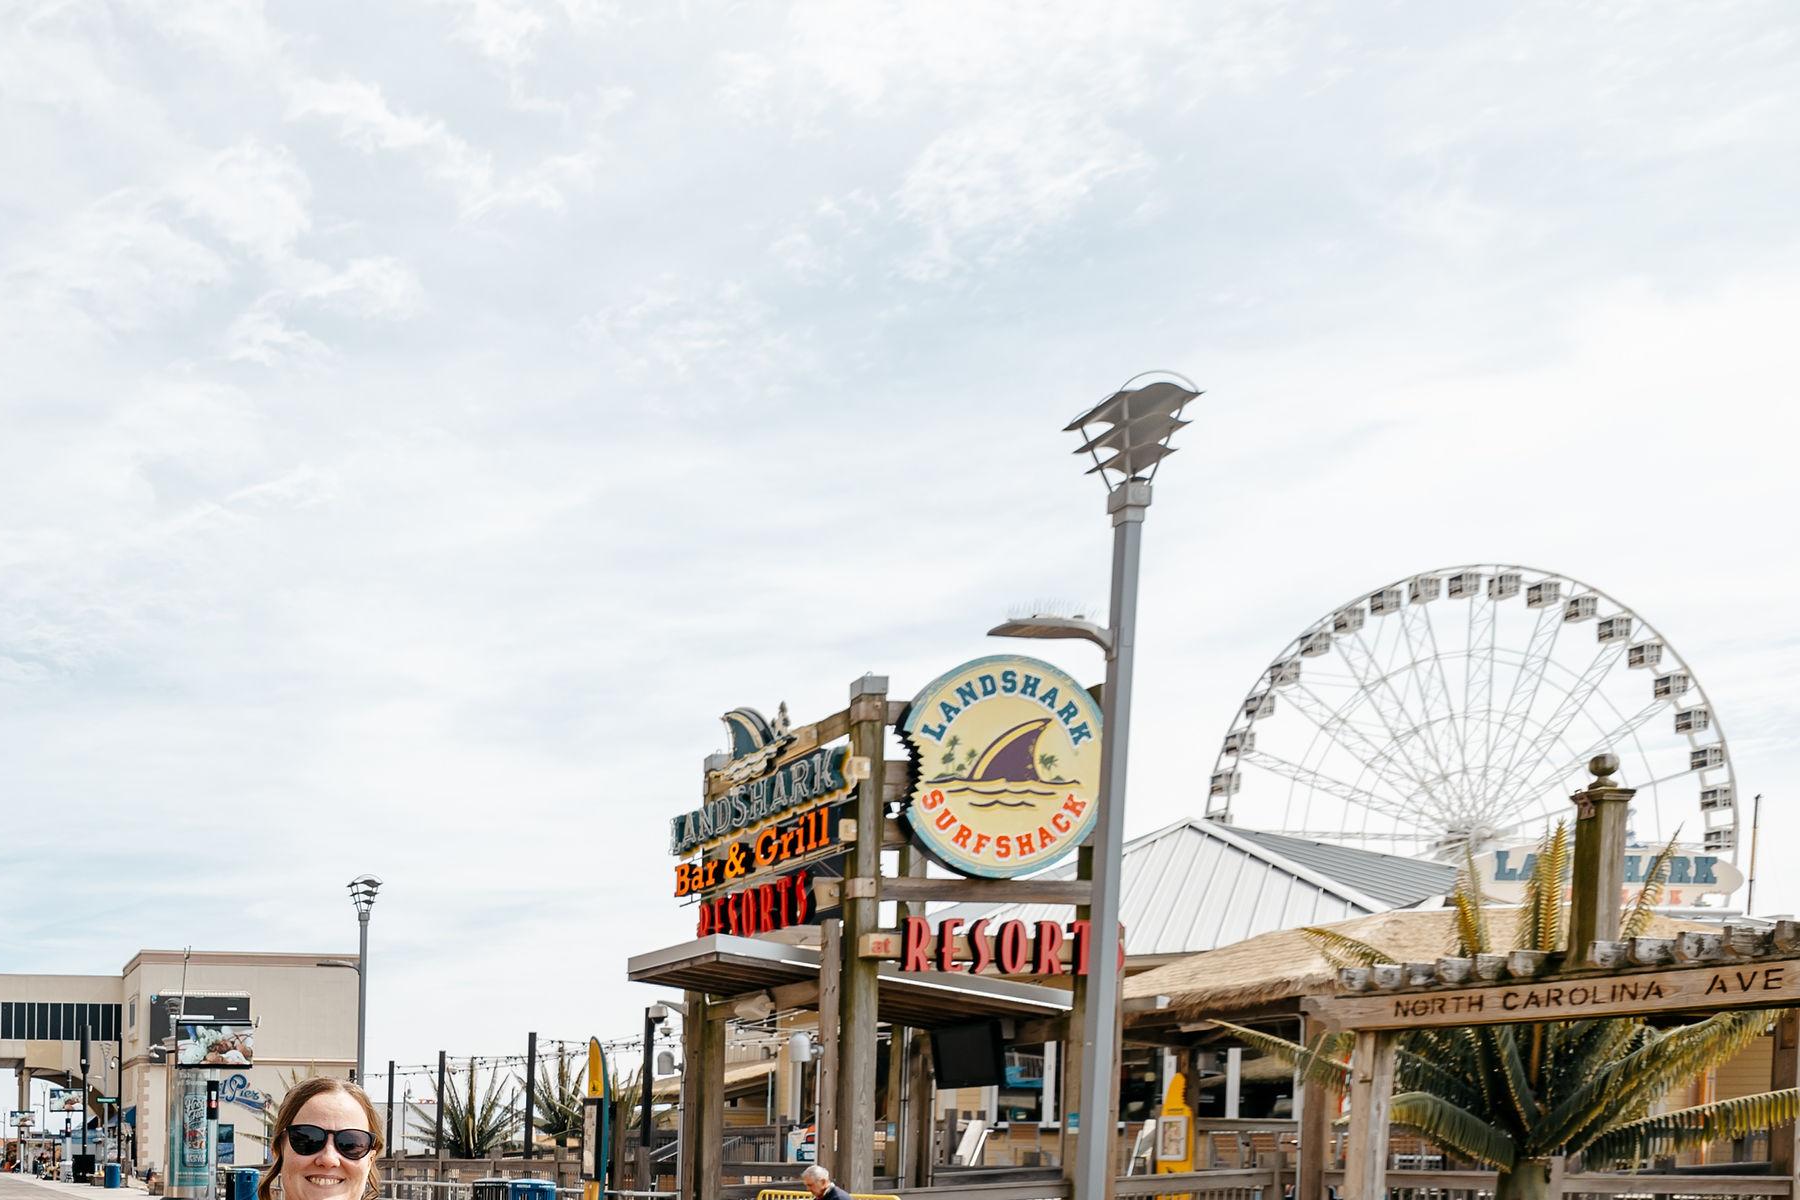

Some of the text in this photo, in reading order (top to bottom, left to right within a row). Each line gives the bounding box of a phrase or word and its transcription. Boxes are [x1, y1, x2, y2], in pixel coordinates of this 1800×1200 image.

[921, 669, 1093, 745] LANDSHARK
[669, 749, 835, 855] LANDSHARK
[921, 789, 1087, 858] SURFSHACK
[674, 807, 830, 898] Bar & Grill
[697, 869, 809, 938] RESORTS
[871, 916, 1124, 976] at RESORT
[1393, 968, 1785, 1018] NORTH CAROLINA AVE
